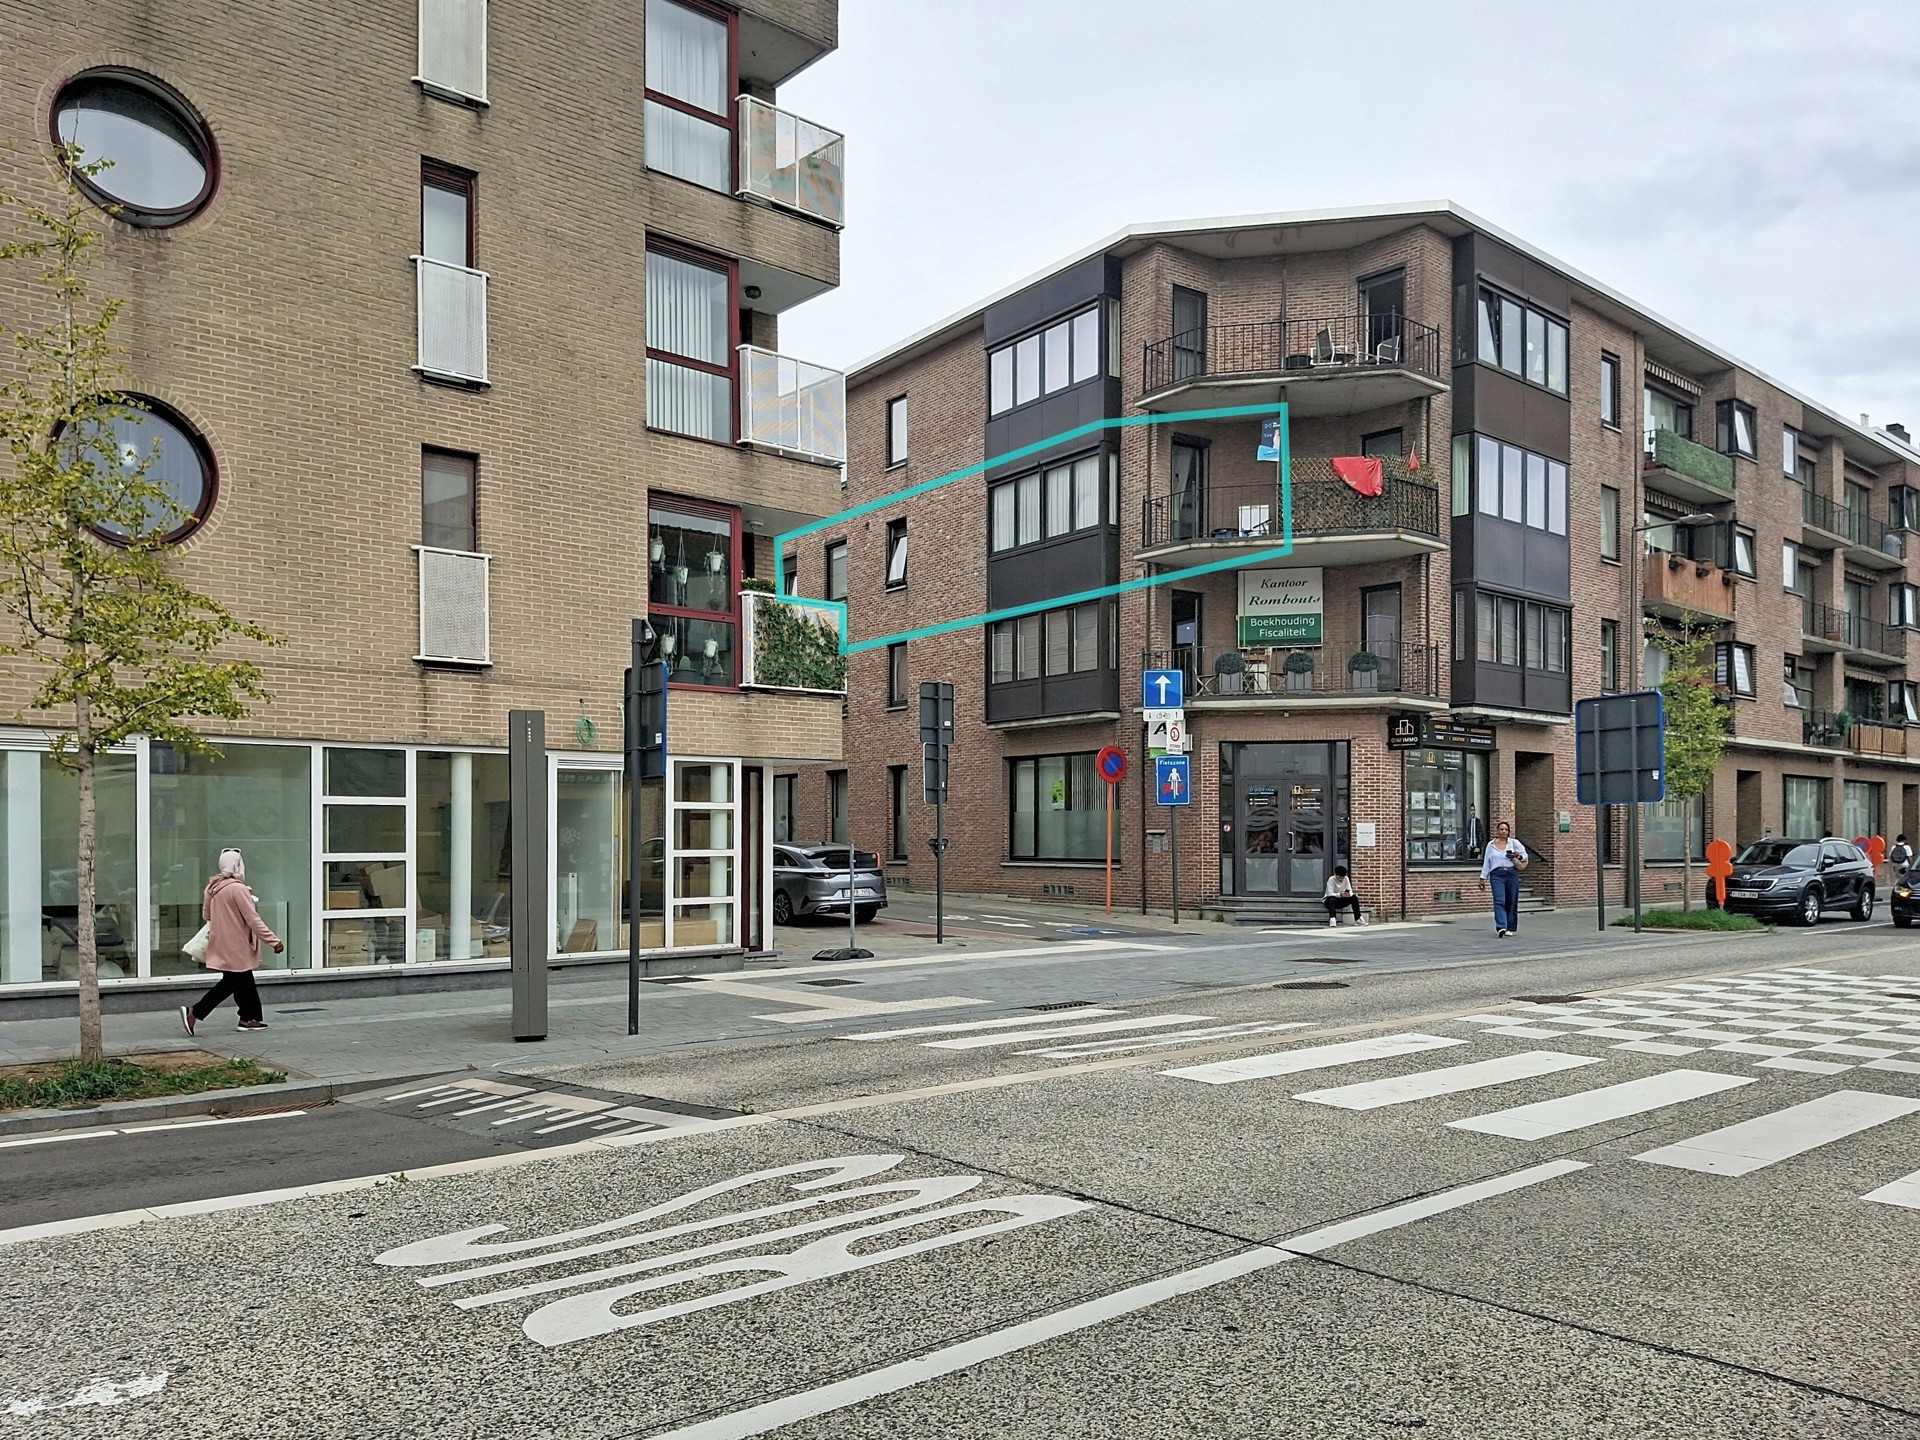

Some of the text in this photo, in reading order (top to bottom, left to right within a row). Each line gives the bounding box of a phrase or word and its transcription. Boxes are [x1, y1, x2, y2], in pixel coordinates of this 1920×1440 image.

[1260, 578, 1308, 589] Kantoor
[1248, 593, 1320, 606] Rombouts
[1250, 616, 1315, 627] Boekhouding
[1259, 627, 1307, 637] Fiscaliteit
[372, 1154, 1097, 1348] BUS
